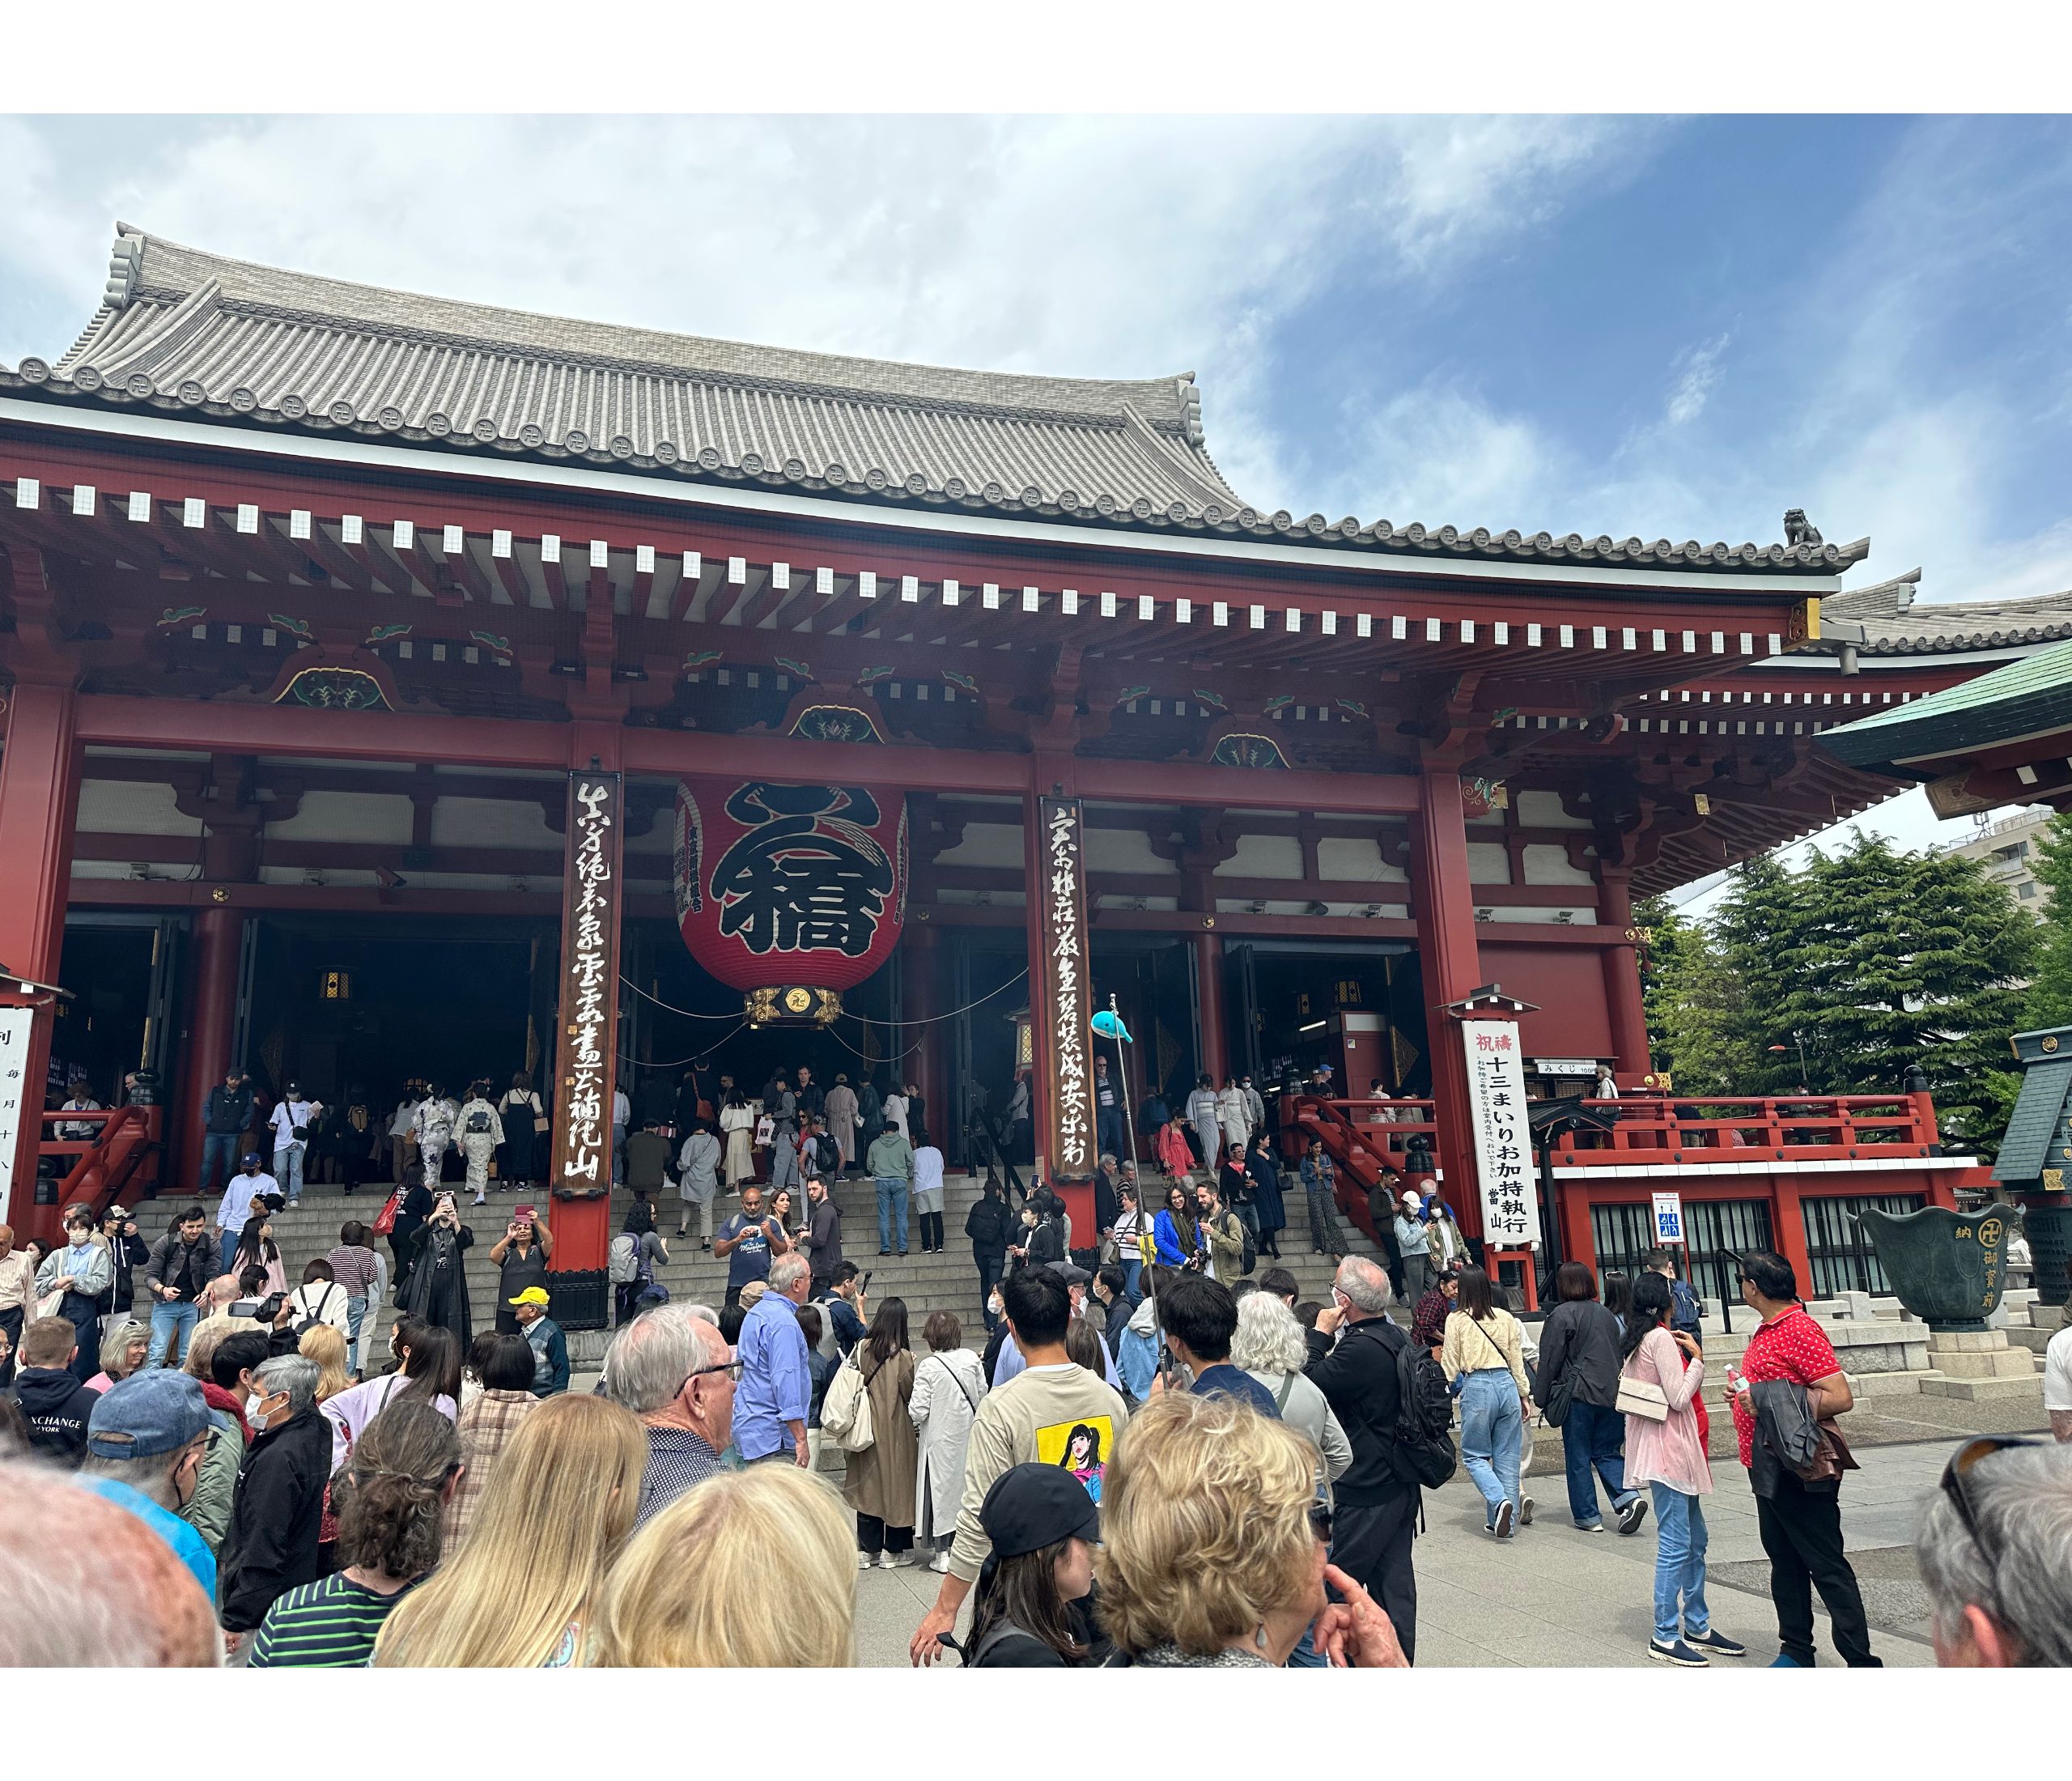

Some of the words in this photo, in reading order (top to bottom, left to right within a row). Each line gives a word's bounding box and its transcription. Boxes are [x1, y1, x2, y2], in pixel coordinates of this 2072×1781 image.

[1544, 1065, 1576, 1073] みくじ
[1486, 1056, 1528, 1234] 十三まいりお加持執行
